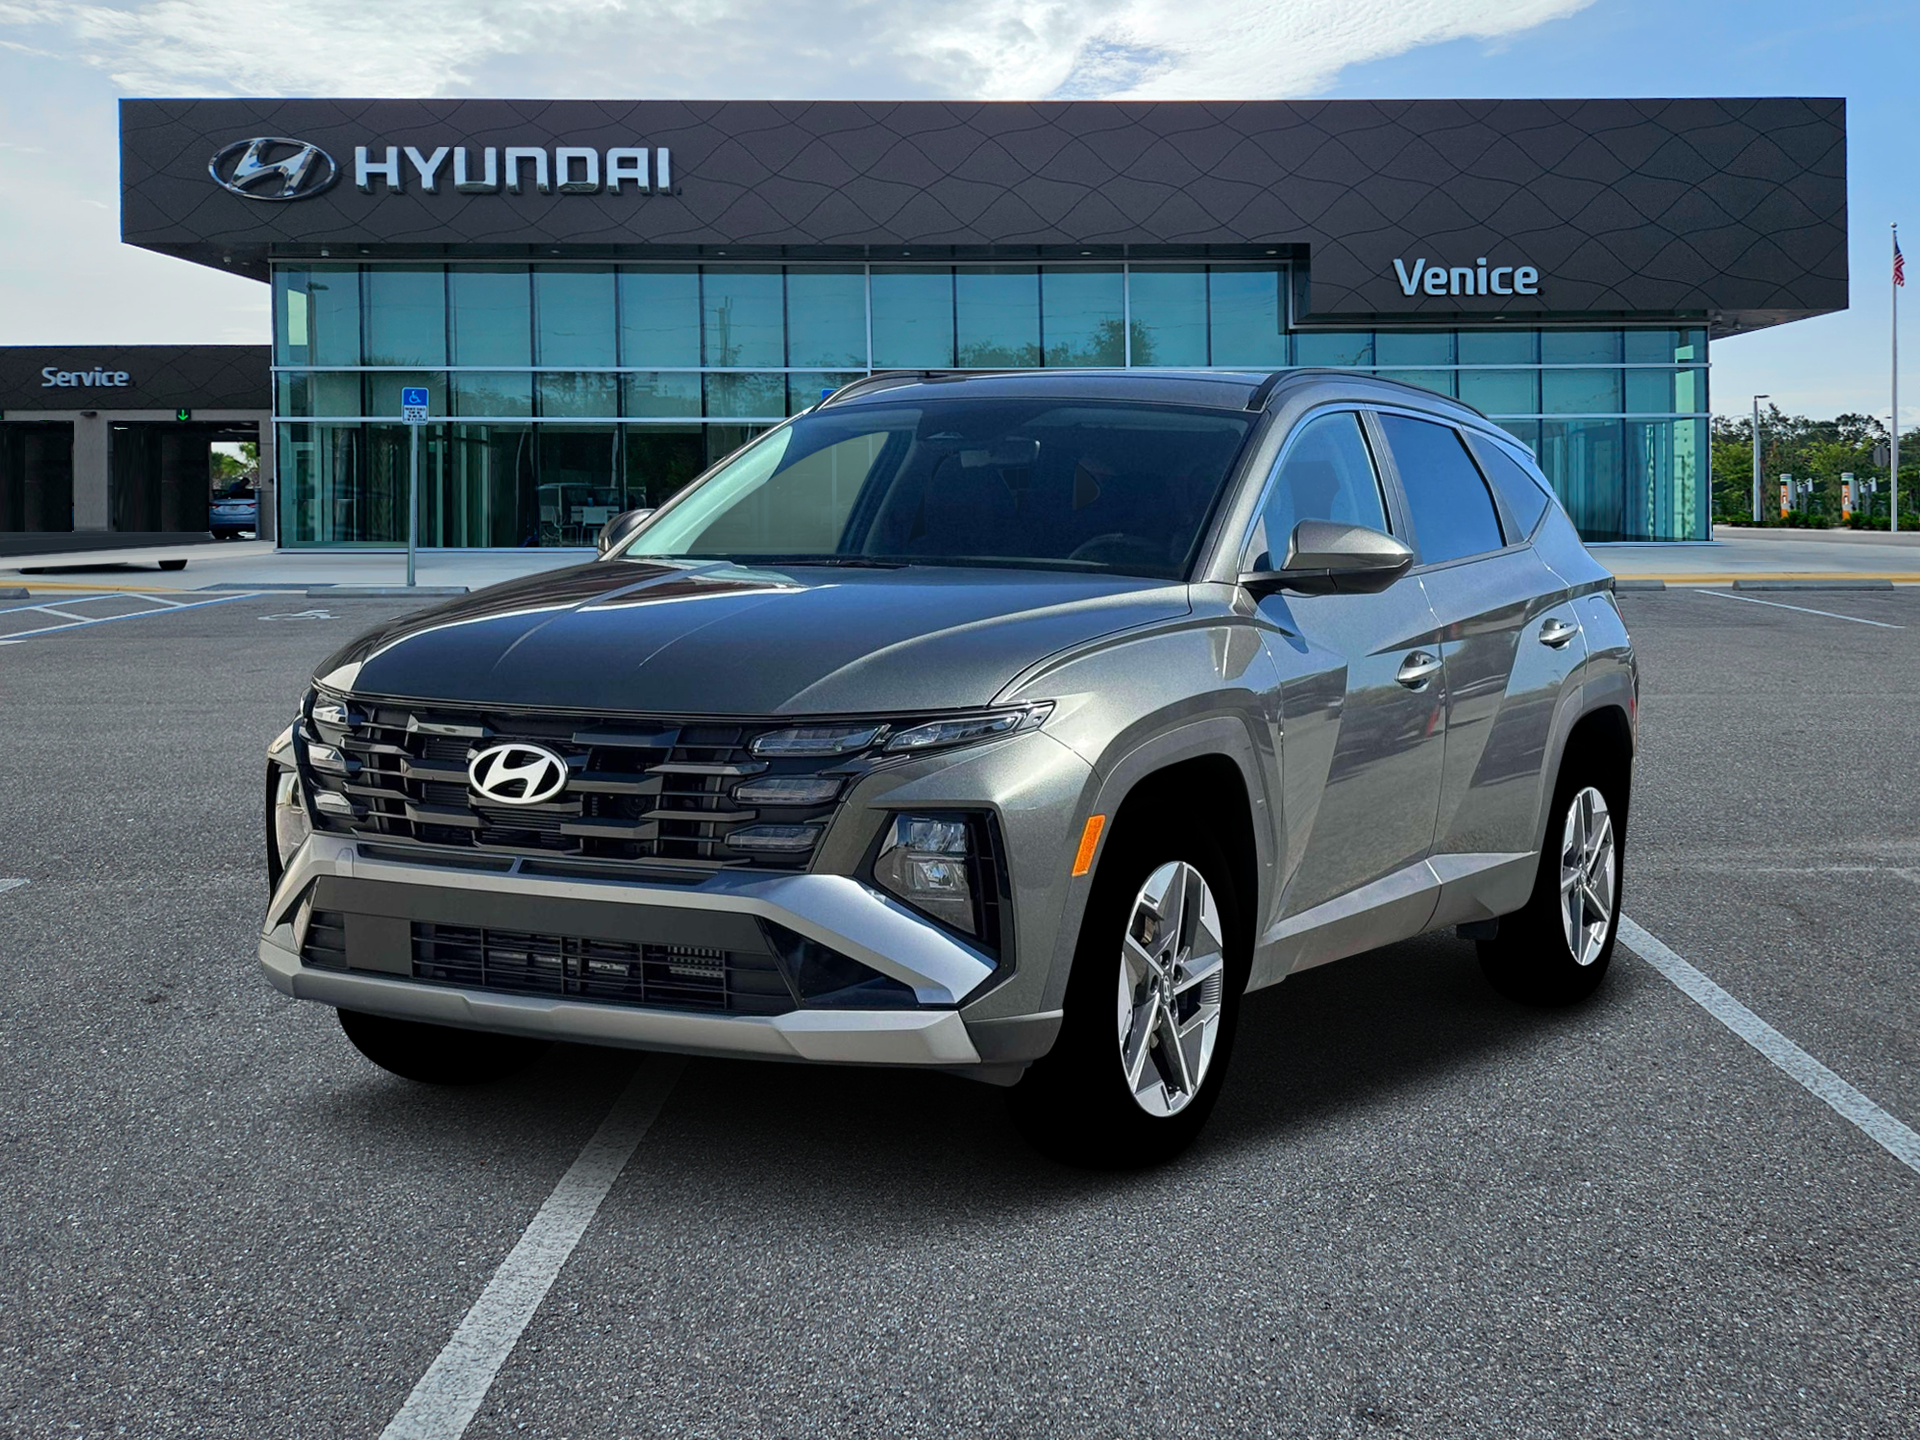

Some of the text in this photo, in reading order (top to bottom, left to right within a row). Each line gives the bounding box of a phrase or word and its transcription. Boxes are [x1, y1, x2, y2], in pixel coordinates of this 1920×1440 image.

[354, 145, 670, 193] HYUNDAI
[1393, 257, 1539, 296] Venice
[41, 366, 130, 387] Service
